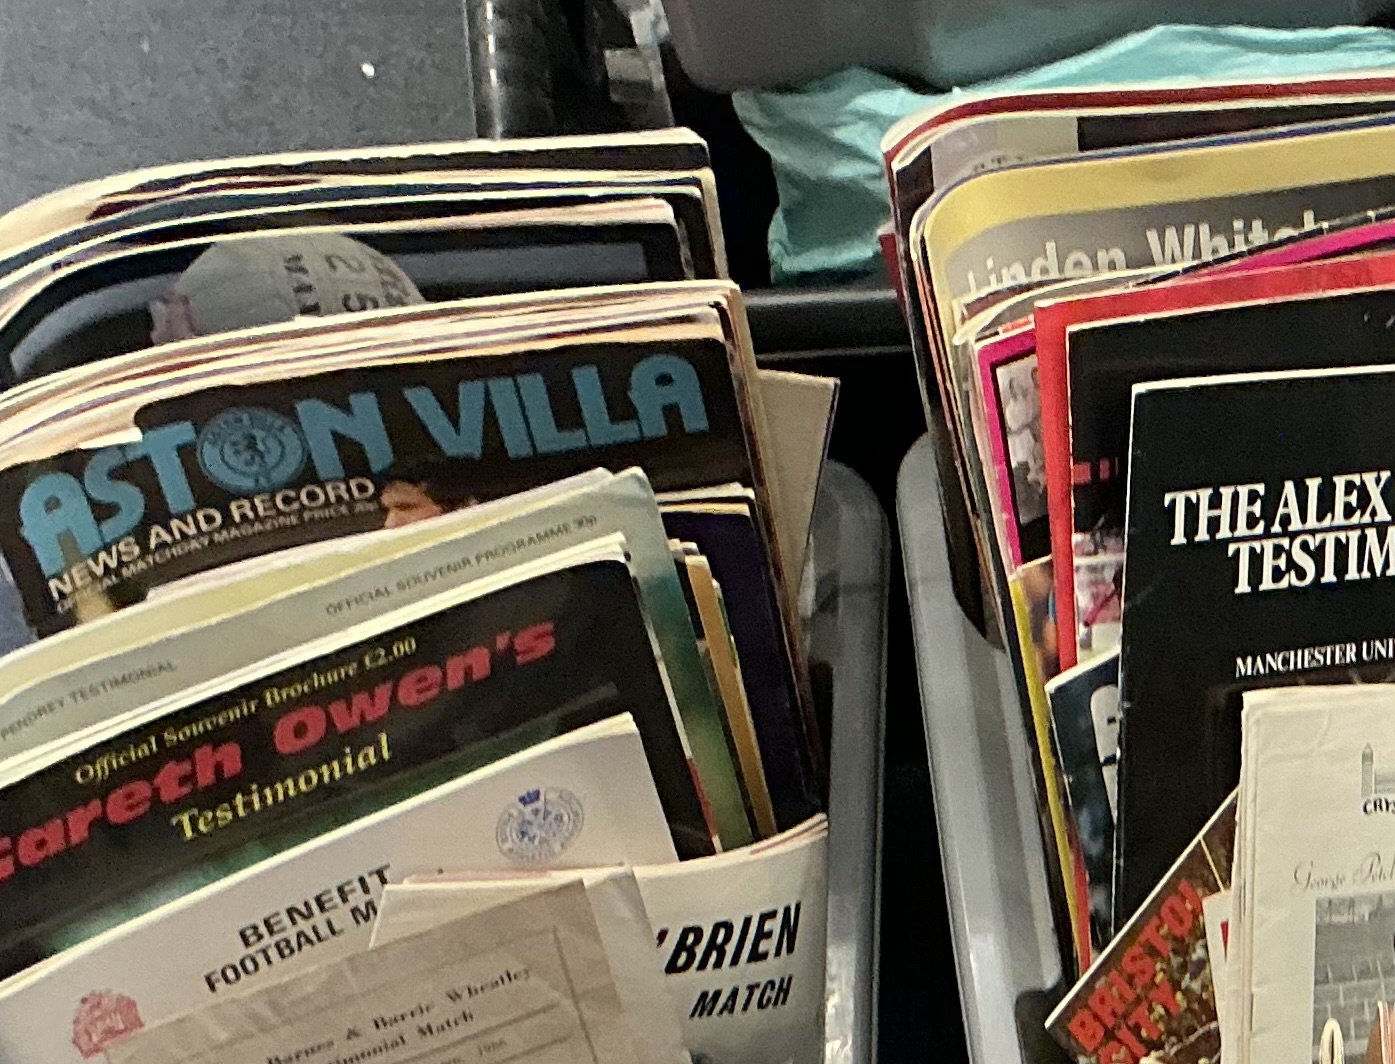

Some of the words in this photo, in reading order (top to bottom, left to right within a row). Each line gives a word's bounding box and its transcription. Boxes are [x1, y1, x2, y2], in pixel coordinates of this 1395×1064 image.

[19, 391, 394, 578] ASTON
[403, 353, 709, 460] VILLA
[48, 535, 141, 601] NEWS
[149, 505, 224, 551] AND
[230, 476, 376, 525] RECORD
[1164, 483, 1266, 546] THE
[1270, 470, 1393, 533] ALEX
[326, 586, 392, 616] OFFICIAL
[397, 557, 473, 592] SOUVENIR
[475, 520, 572, 566] PROGRAMME
[69, 660, 177, 704] TESTIMONIAL
[273, 621, 556, 755] Owen's
[1235, 643, 1357, 679] MANCHESTER
[75, 735, 158, 785] Official
[163, 698, 259, 747] Souvenir
[263, 661, 358, 709] Brochure
[364, 635, 417, 672] £2.00
[170, 731, 391, 842] Testimonial
[238, 863, 391, 950] BENEFIT
[203, 917, 345, 994] FOOTBALL
[373, 1002, 436, 1032] Barrie
[445, 965, 532, 1003] Wheatley
[416, 1009, 474, 1040] Match
[689, 974, 794, 1020] MATCH
